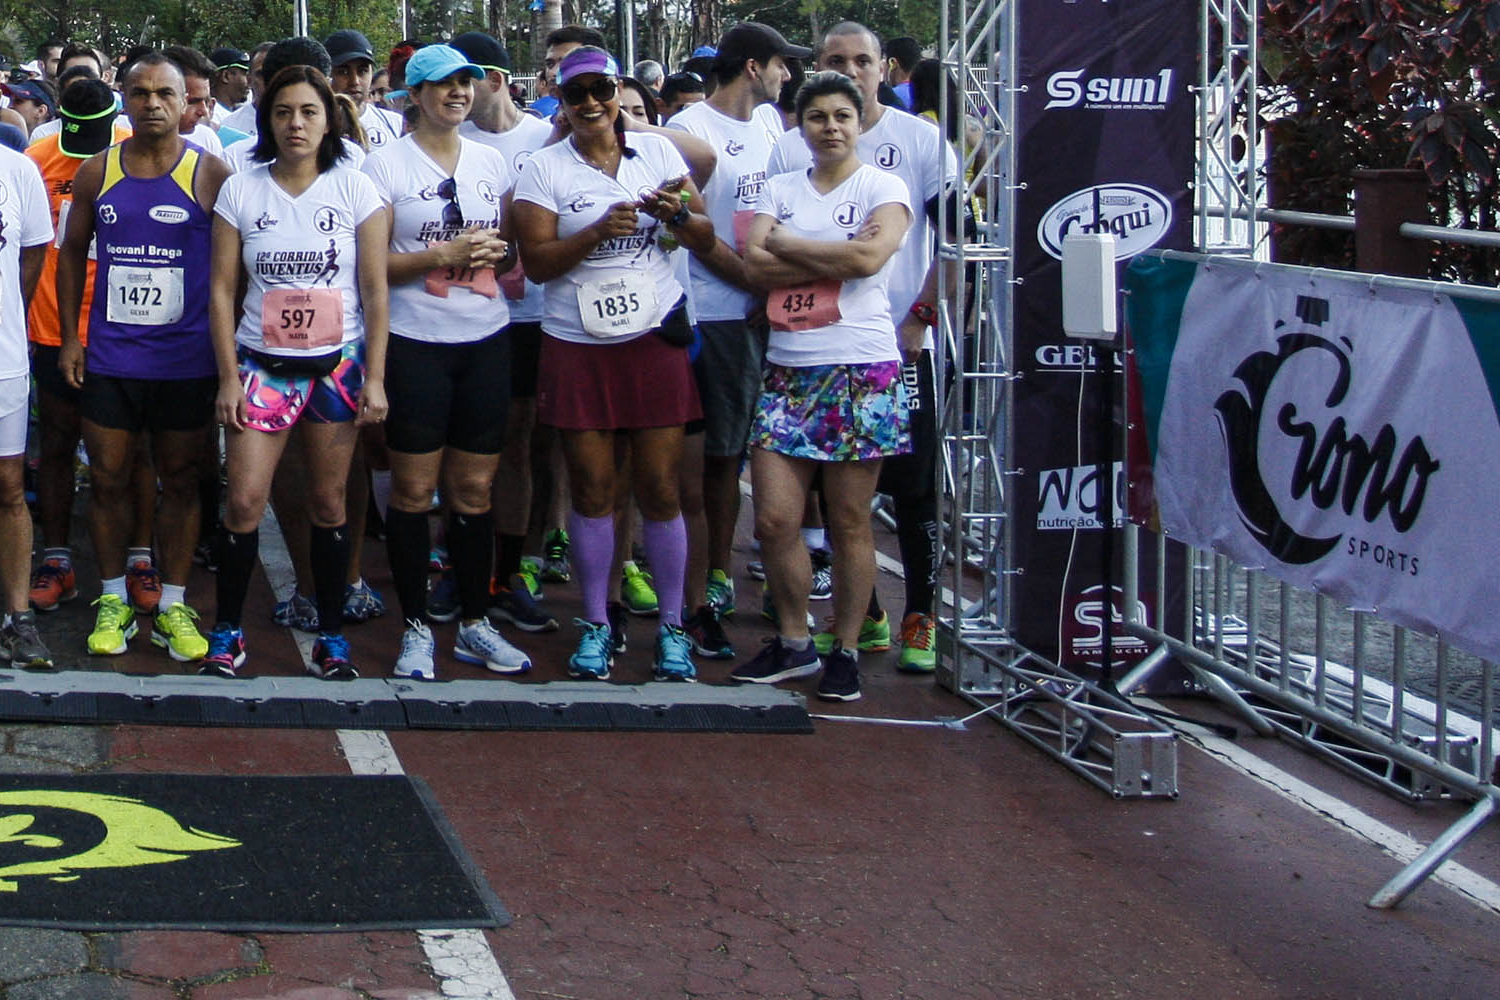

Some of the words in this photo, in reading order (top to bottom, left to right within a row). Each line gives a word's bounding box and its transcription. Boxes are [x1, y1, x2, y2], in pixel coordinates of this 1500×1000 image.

[148, 245, 182, 259] Braga
[273, 251, 323, 262] CORRIDA
[256, 262, 323, 276] JUVENTUS
[119, 286, 162, 306] 1472
[593, 293, 639, 319] 1835
[782, 293, 814, 313] 434
[280, 309, 316, 329] 597
[1037, 518, 1094, 528] nutrição
[1347, 536, 1420, 577] SPORTS
